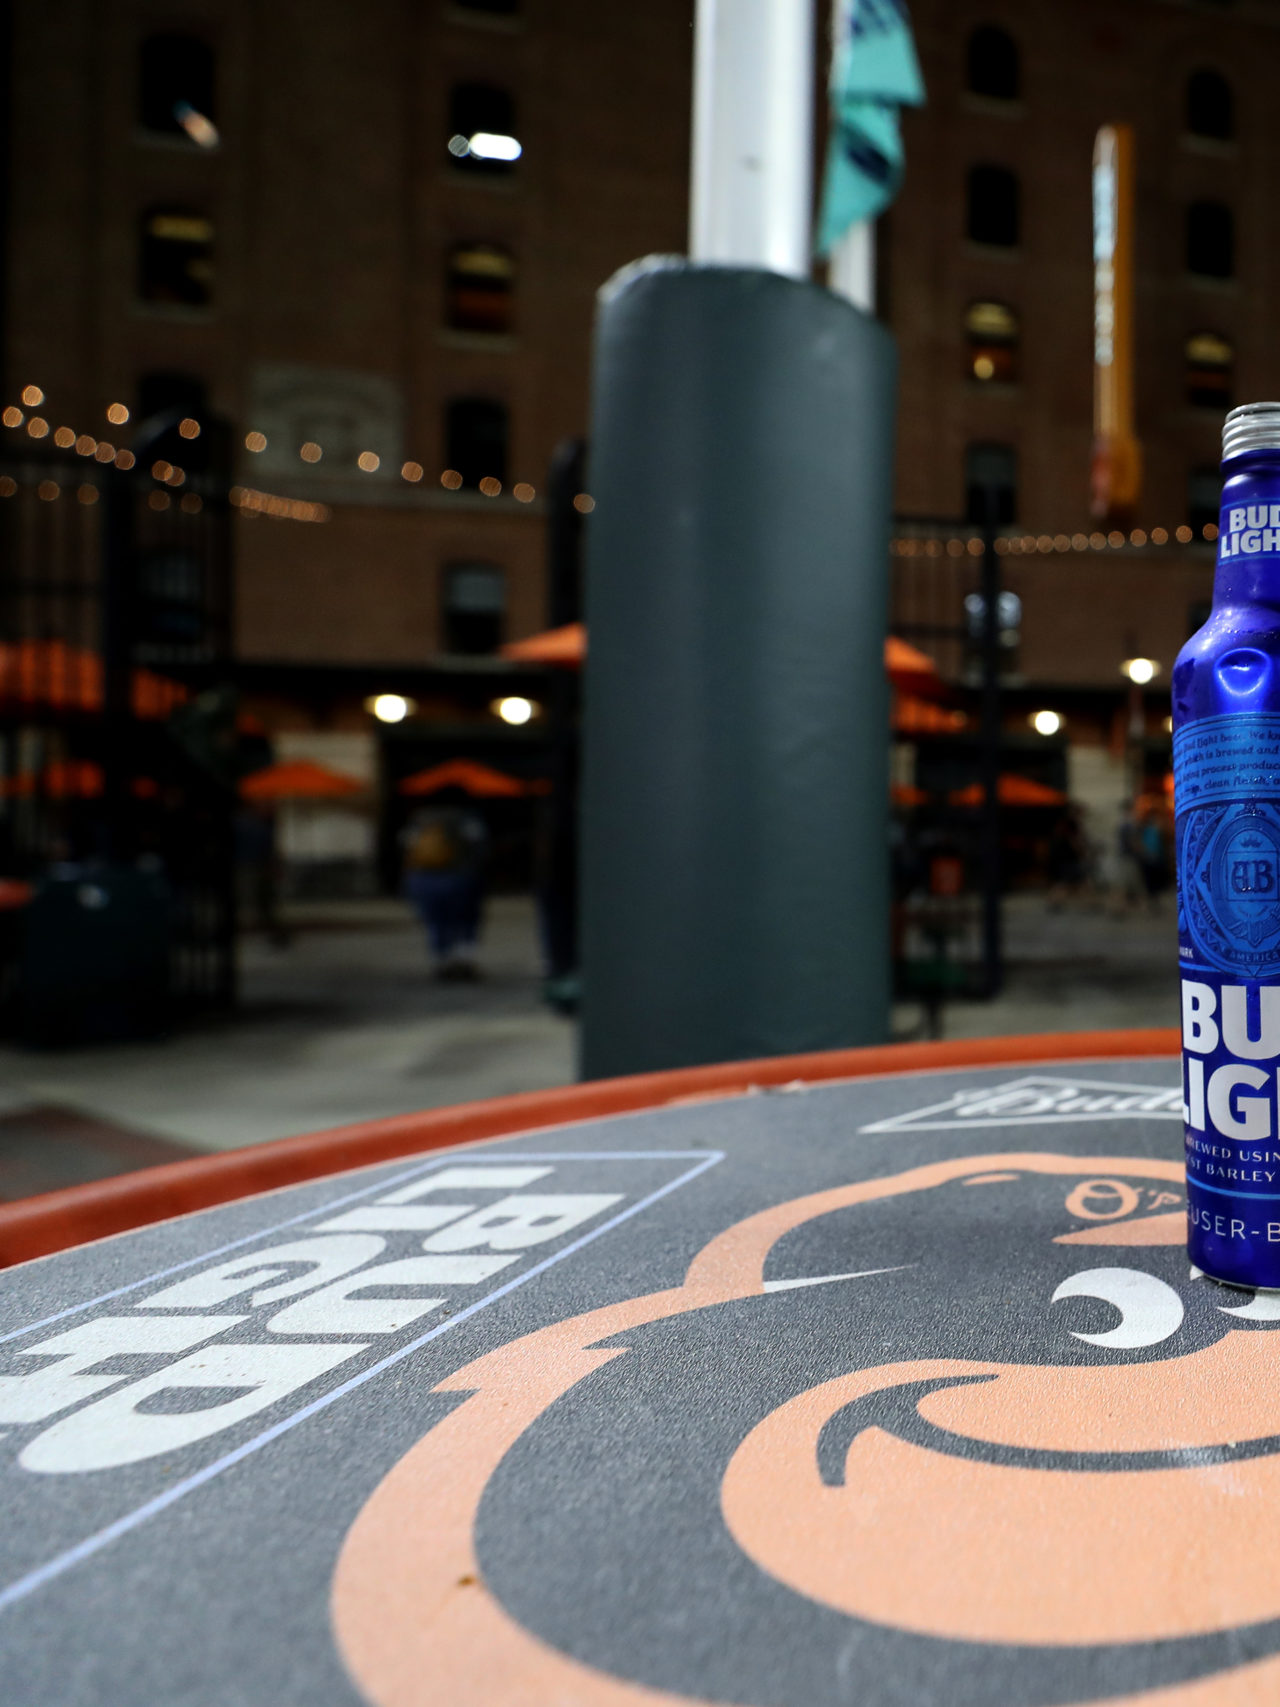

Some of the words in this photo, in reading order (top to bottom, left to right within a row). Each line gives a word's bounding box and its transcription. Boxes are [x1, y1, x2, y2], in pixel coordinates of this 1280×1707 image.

[1215, 744, 1254, 758] brewed
[1255, 744, 1280, 755] and
[1228, 950, 1280, 962] AMERICA
[1206, 1164, 1276, 1182] BARLEY
[0, 1166, 556, 1428] LIGH
[18, 1193, 627, 1475] BUD
